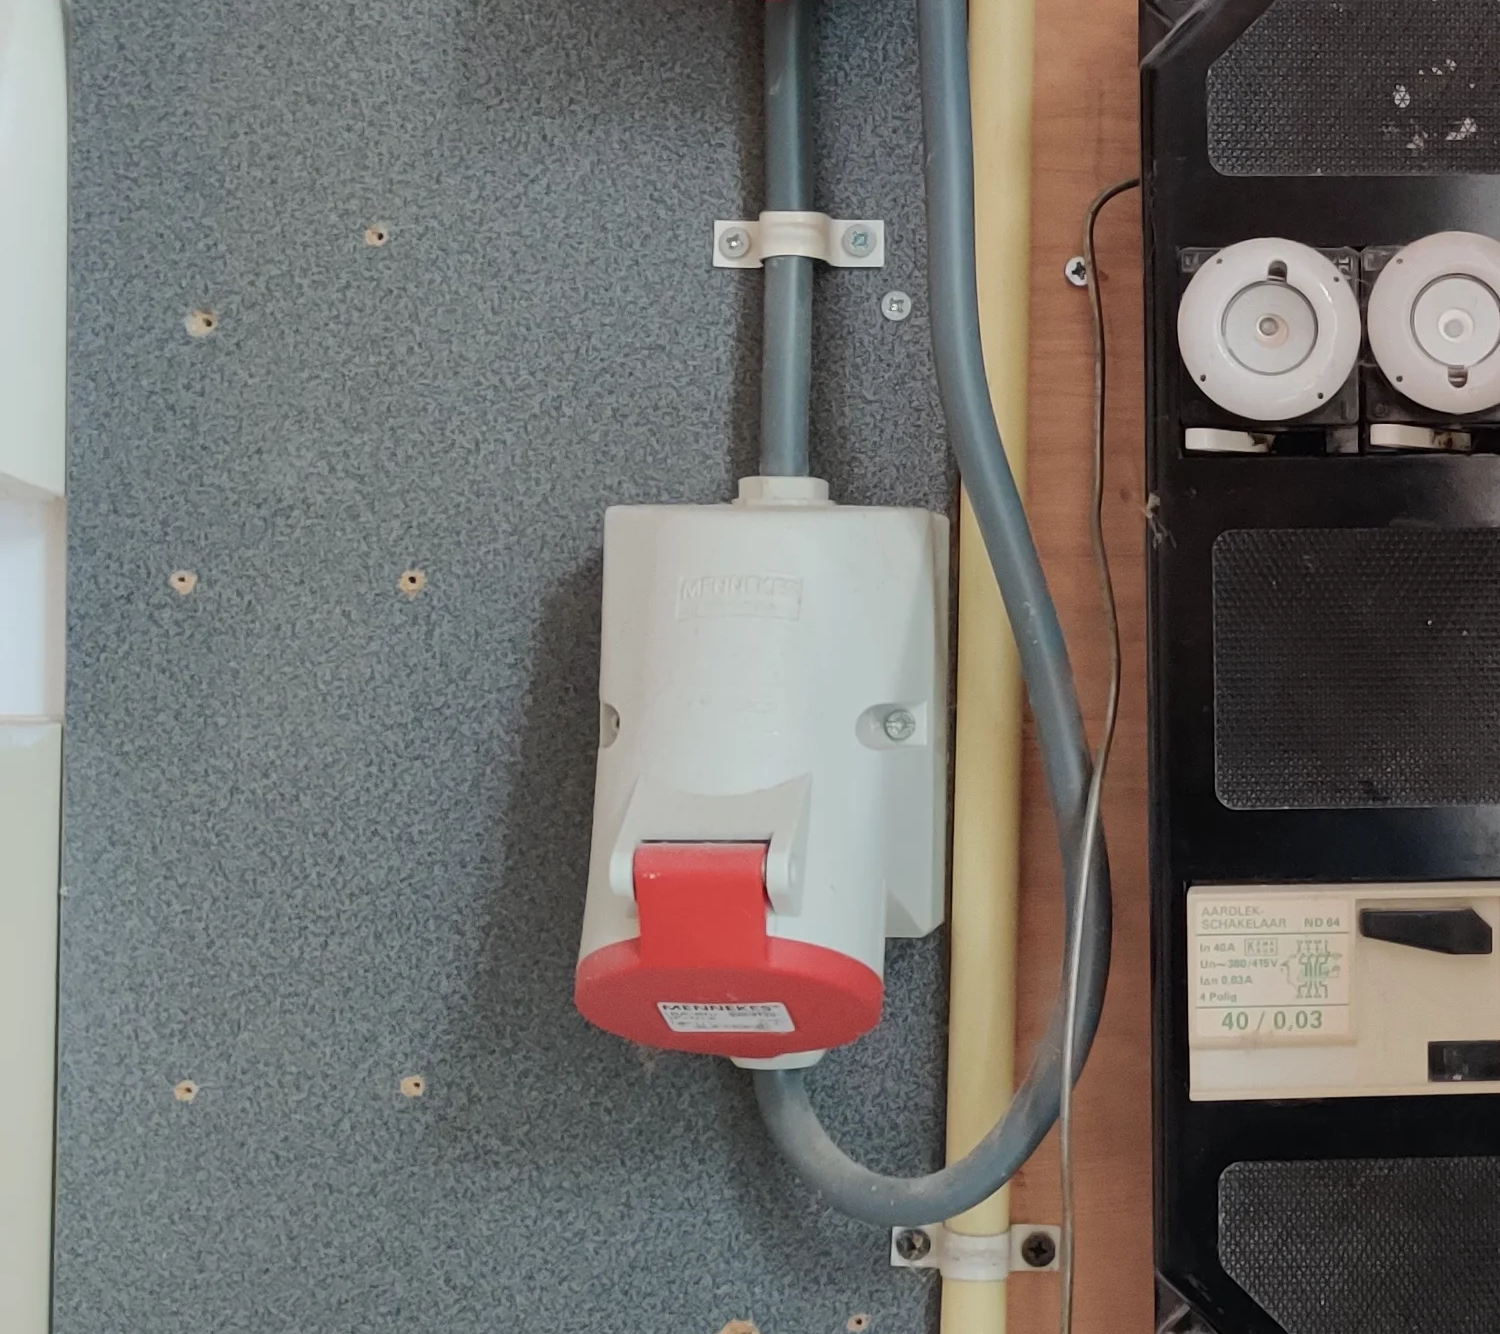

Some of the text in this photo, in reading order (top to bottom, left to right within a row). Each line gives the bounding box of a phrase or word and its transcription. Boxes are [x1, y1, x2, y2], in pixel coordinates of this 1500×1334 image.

[1201, 905, 1264, 917] AARDLEK-
[1201, 917, 1287, 930] SCHAKELAAR
[1304, 917, 1323, 928] ND
[1209, 992, 1237, 1003] Polig
[1221, 1011, 1249, 1031] 40
[1273, 1009, 1323, 1032] 0,03
